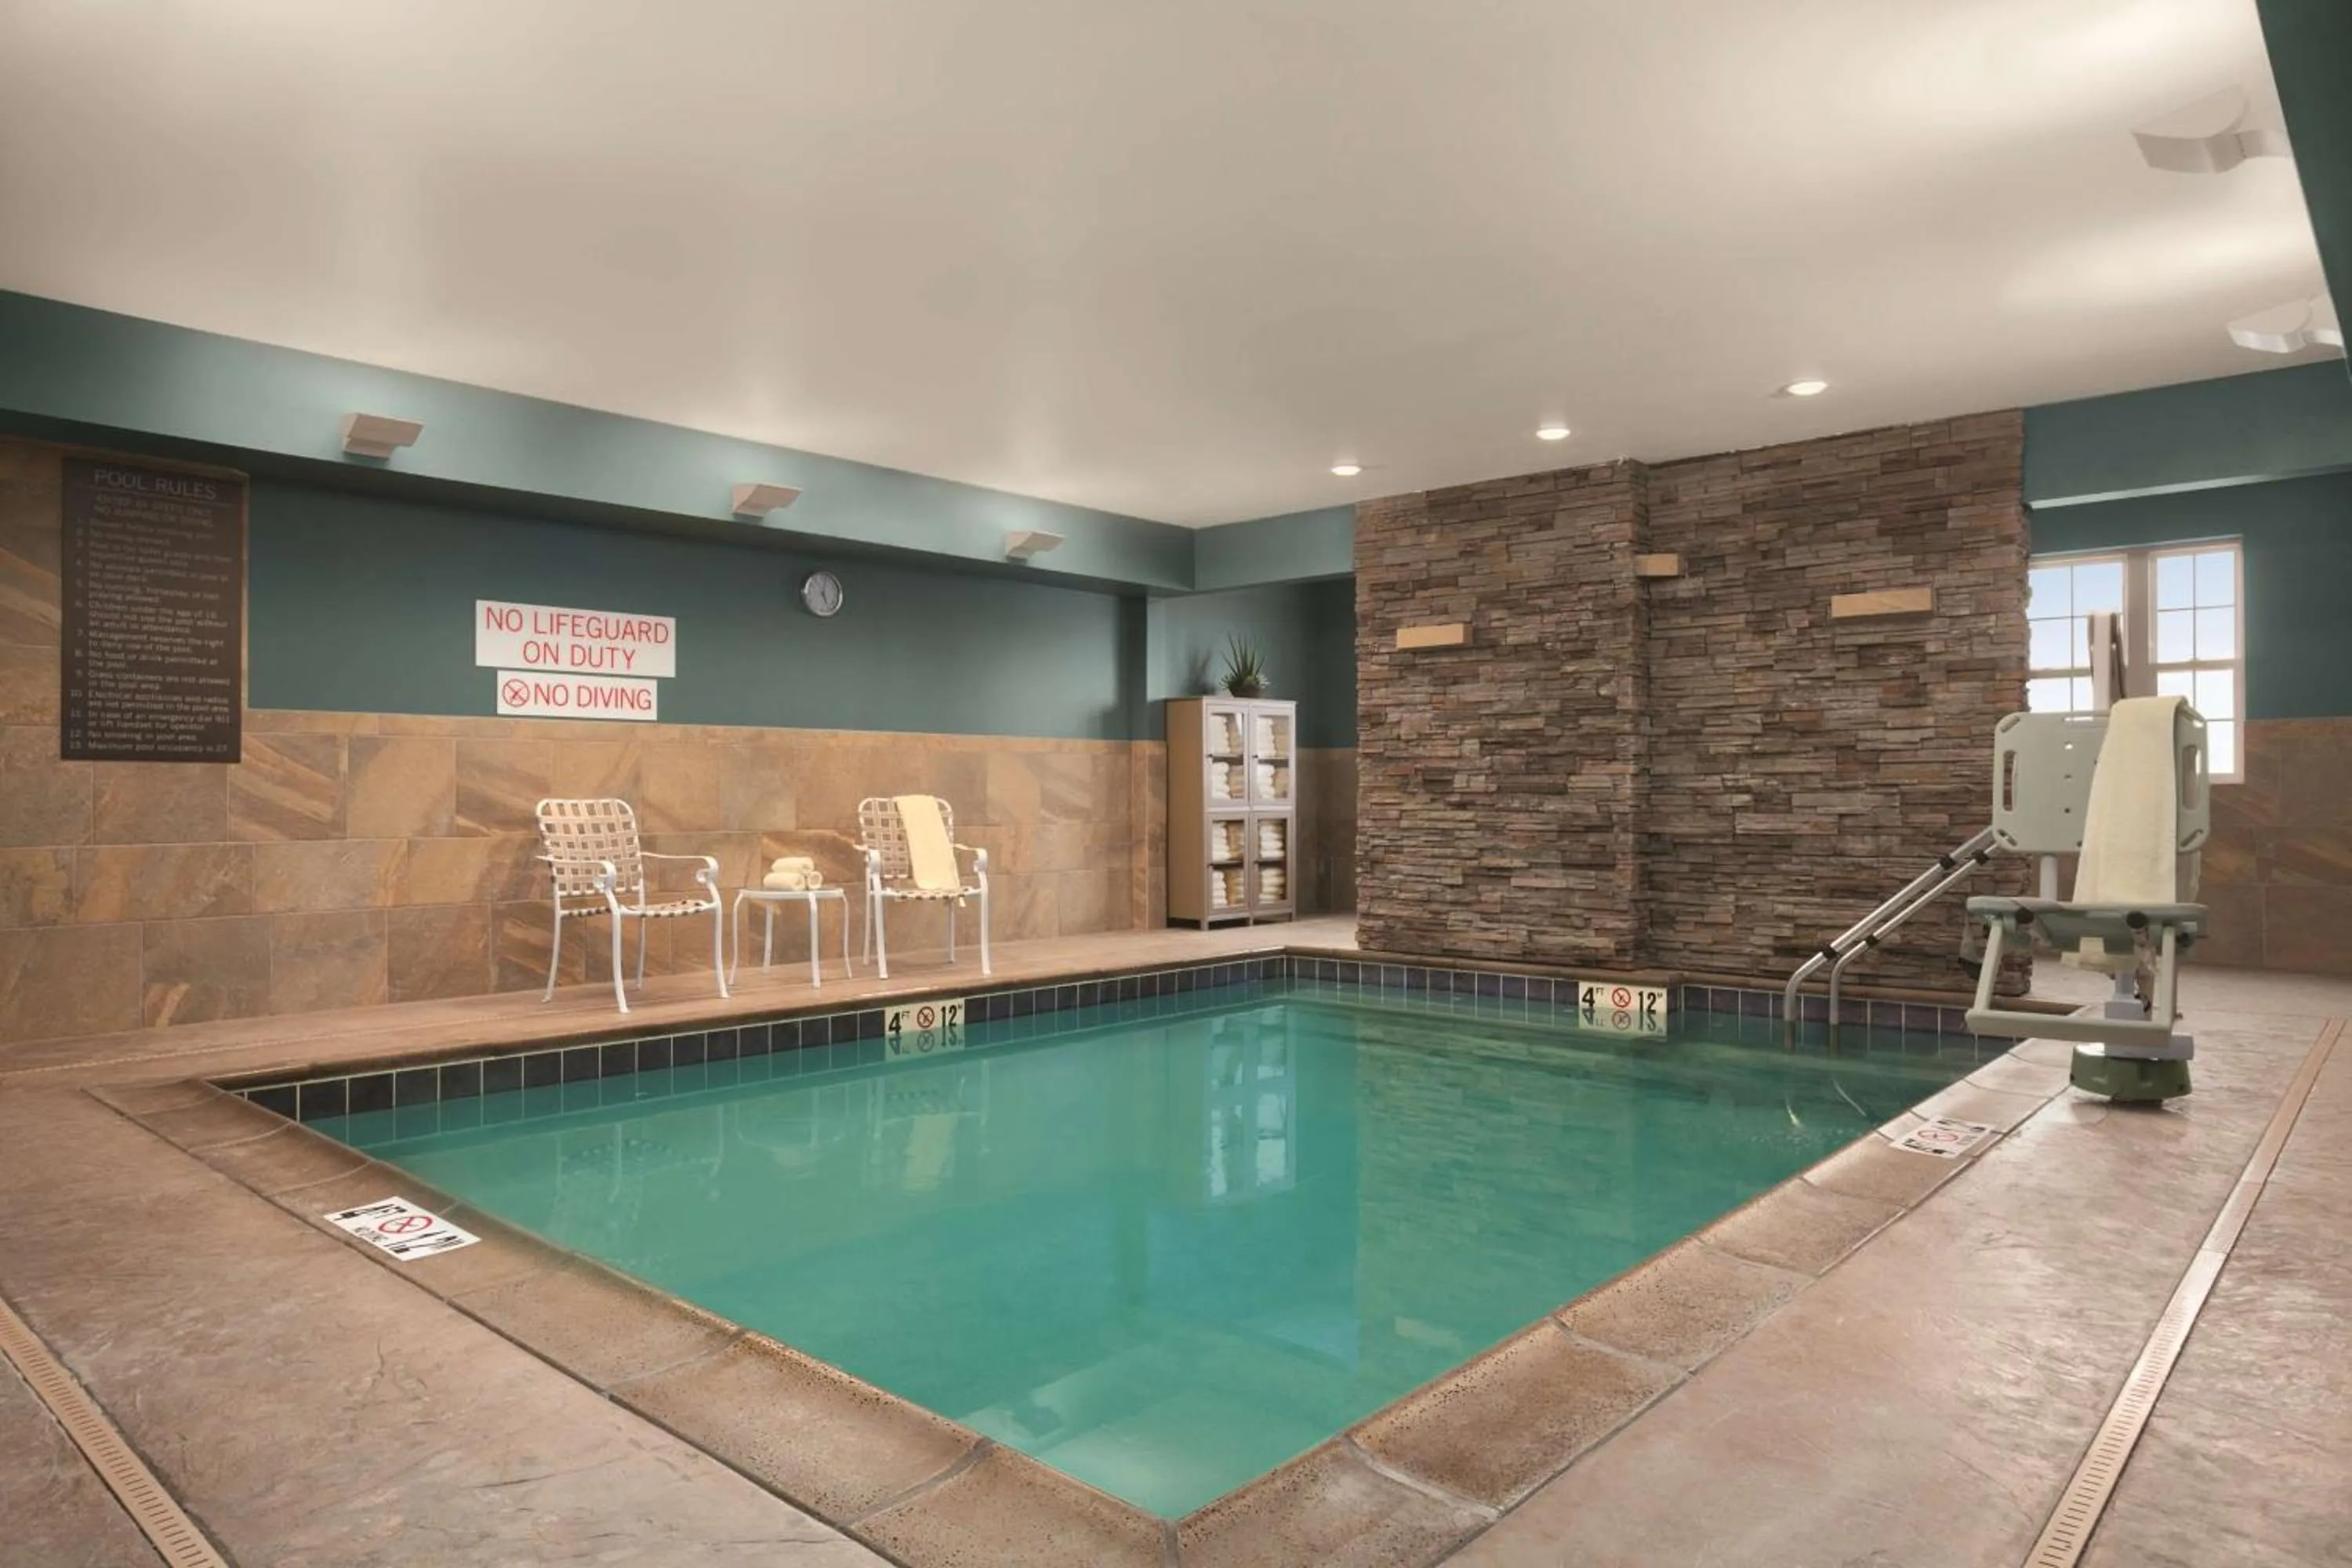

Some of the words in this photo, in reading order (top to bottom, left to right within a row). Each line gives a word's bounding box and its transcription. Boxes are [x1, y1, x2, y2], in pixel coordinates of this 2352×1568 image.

[94, 470, 147, 491] POOL
[155, 477, 217, 501] RULES
[485, 606, 523, 633] NO
[533, 611, 669, 644] LIFEGUARD
[523, 640, 559, 665] ON
[570, 644, 636, 669] DUTY
[534, 683, 569, 706] NO
[576, 684, 652, 710] DIVING
